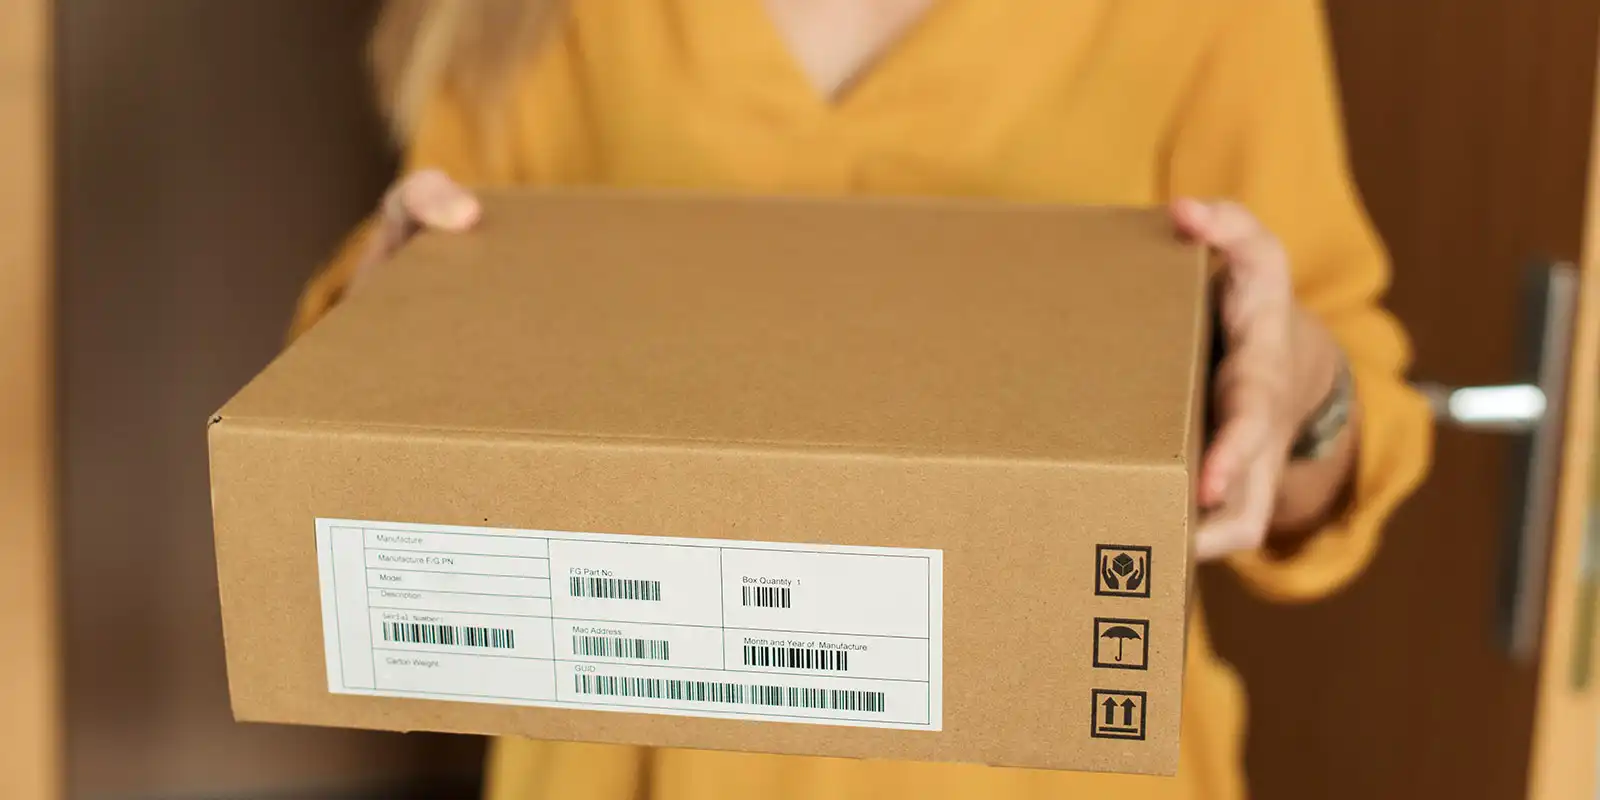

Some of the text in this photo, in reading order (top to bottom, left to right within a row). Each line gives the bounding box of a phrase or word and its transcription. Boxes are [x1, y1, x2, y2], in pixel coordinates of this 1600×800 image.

[377, 534, 423, 545] Manufacture
[378, 554, 424, 565] Manufacture
[569, 567, 582, 575] FG
[584, 568, 600, 577] Part
[742, 576, 758, 584] Box
[759, 576, 792, 586] Quantity
[382, 612, 409, 621] Serial
[572, 626, 622, 635] Mac Address
[744, 637, 868, 651] Month and Year of Manufacture
[575, 664, 596, 673] GUID
